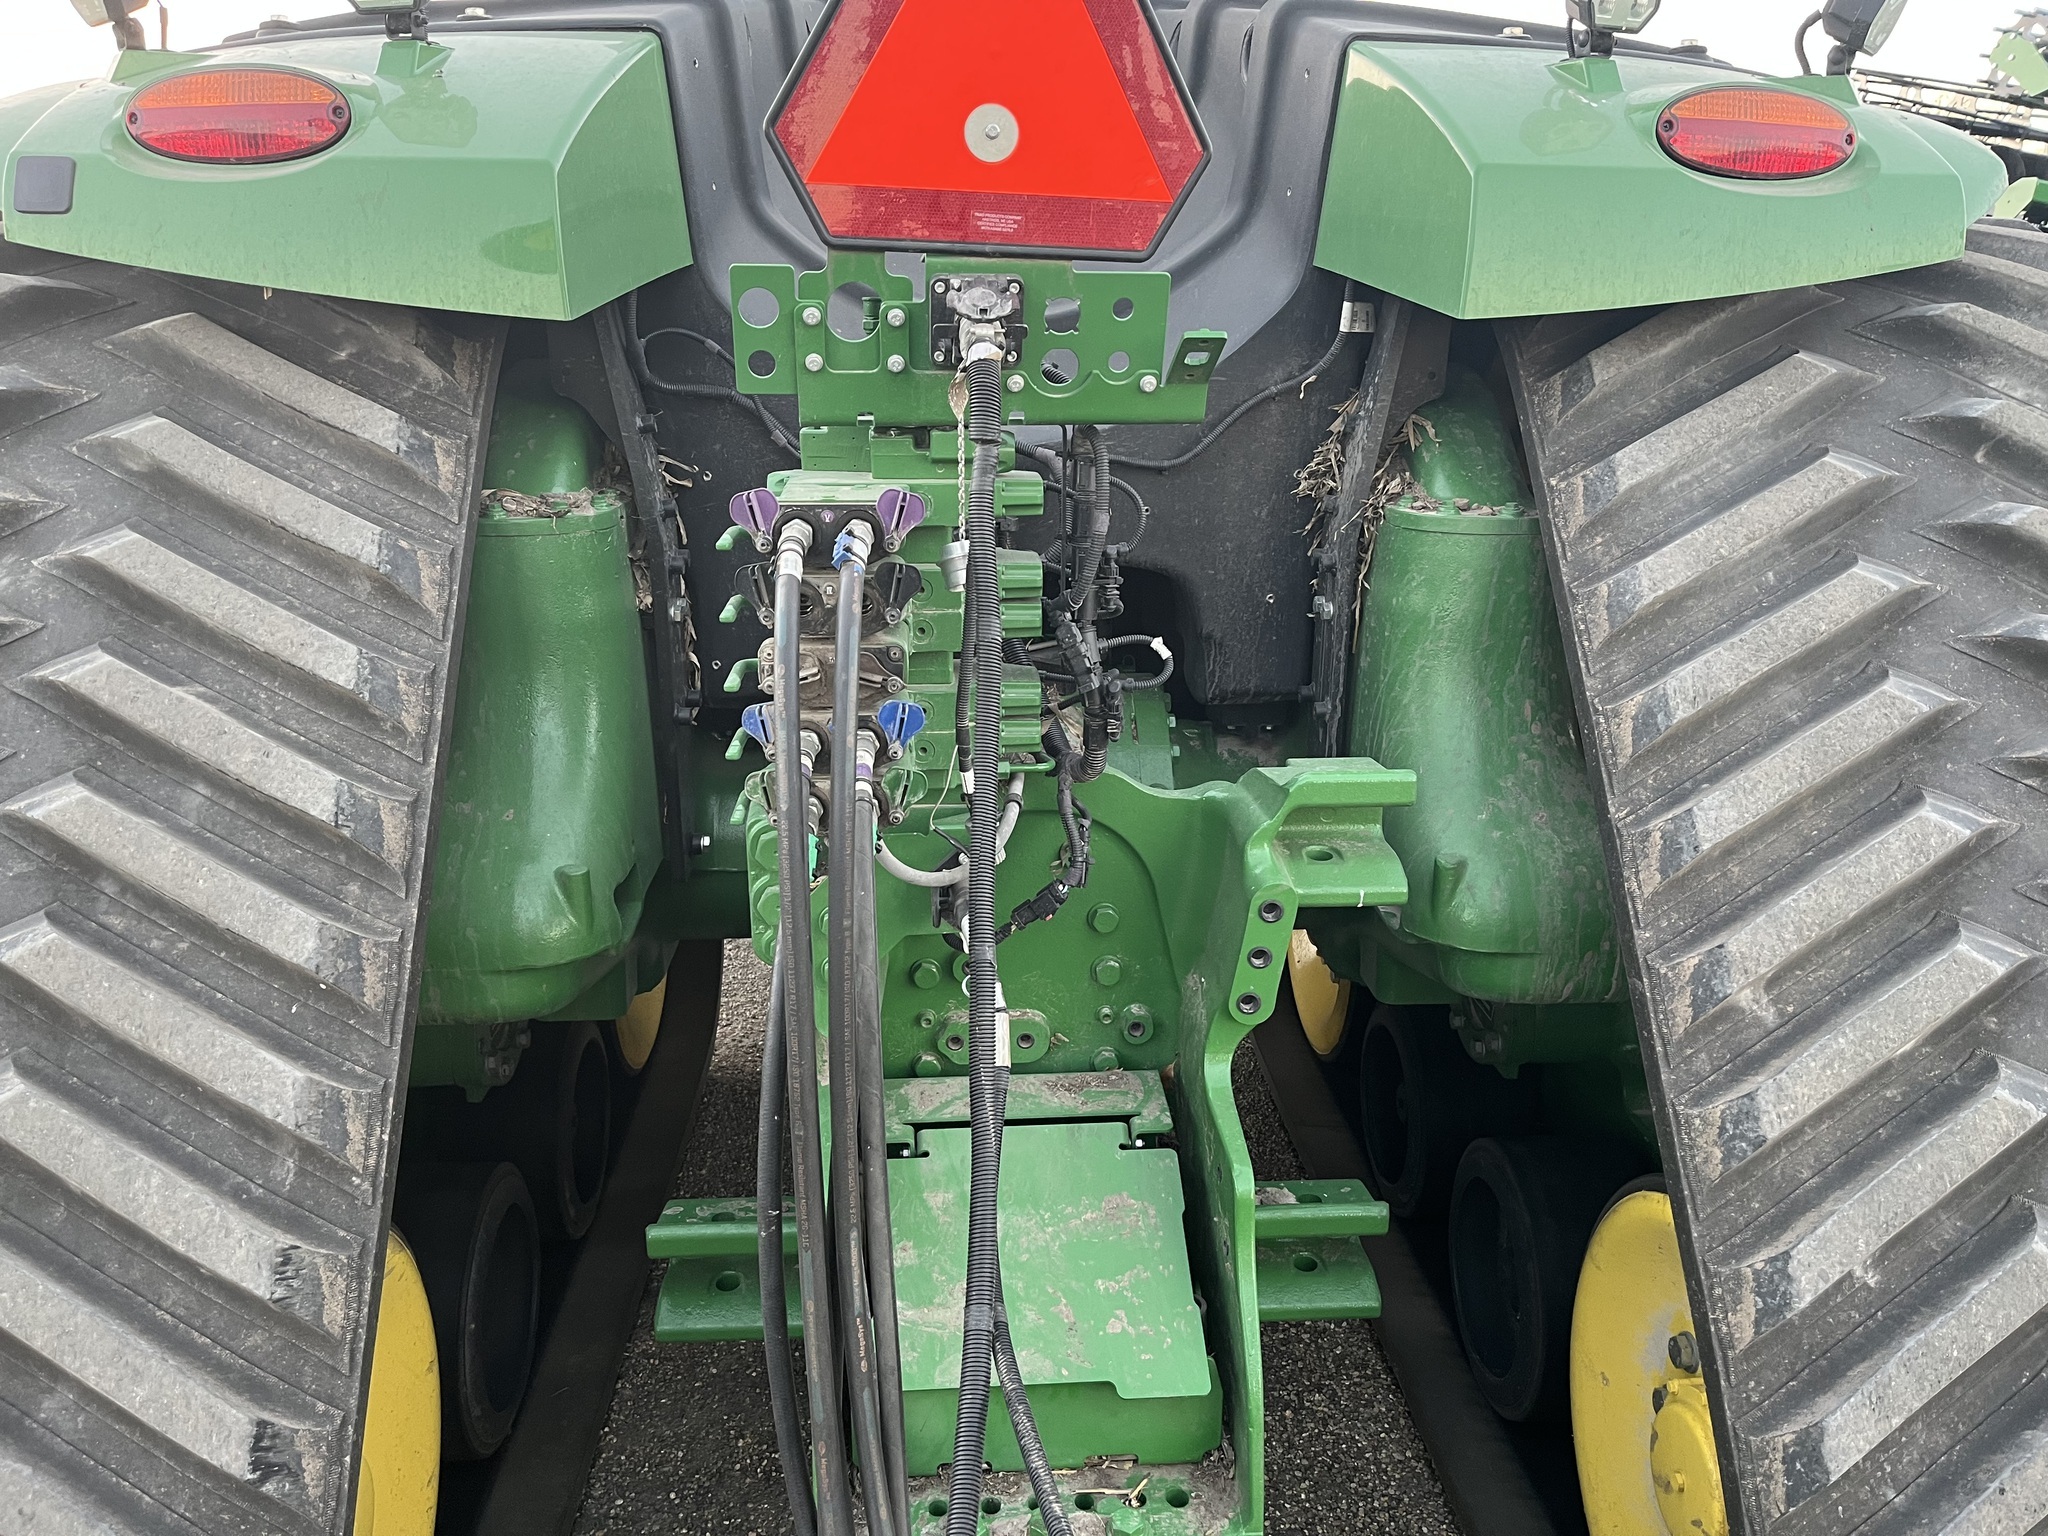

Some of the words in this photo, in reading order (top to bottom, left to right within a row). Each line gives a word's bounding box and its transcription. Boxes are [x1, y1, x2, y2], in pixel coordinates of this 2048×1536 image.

[781, 820, 789, 837] 22.5
[787, 955, 795, 968] ISO
[788, 970, 796, 993] 11237
[793, 1079, 801, 1101] 18752
[797, 1164, 806, 1198] Resistant
[800, 1199, 808, 1219] MSHA
